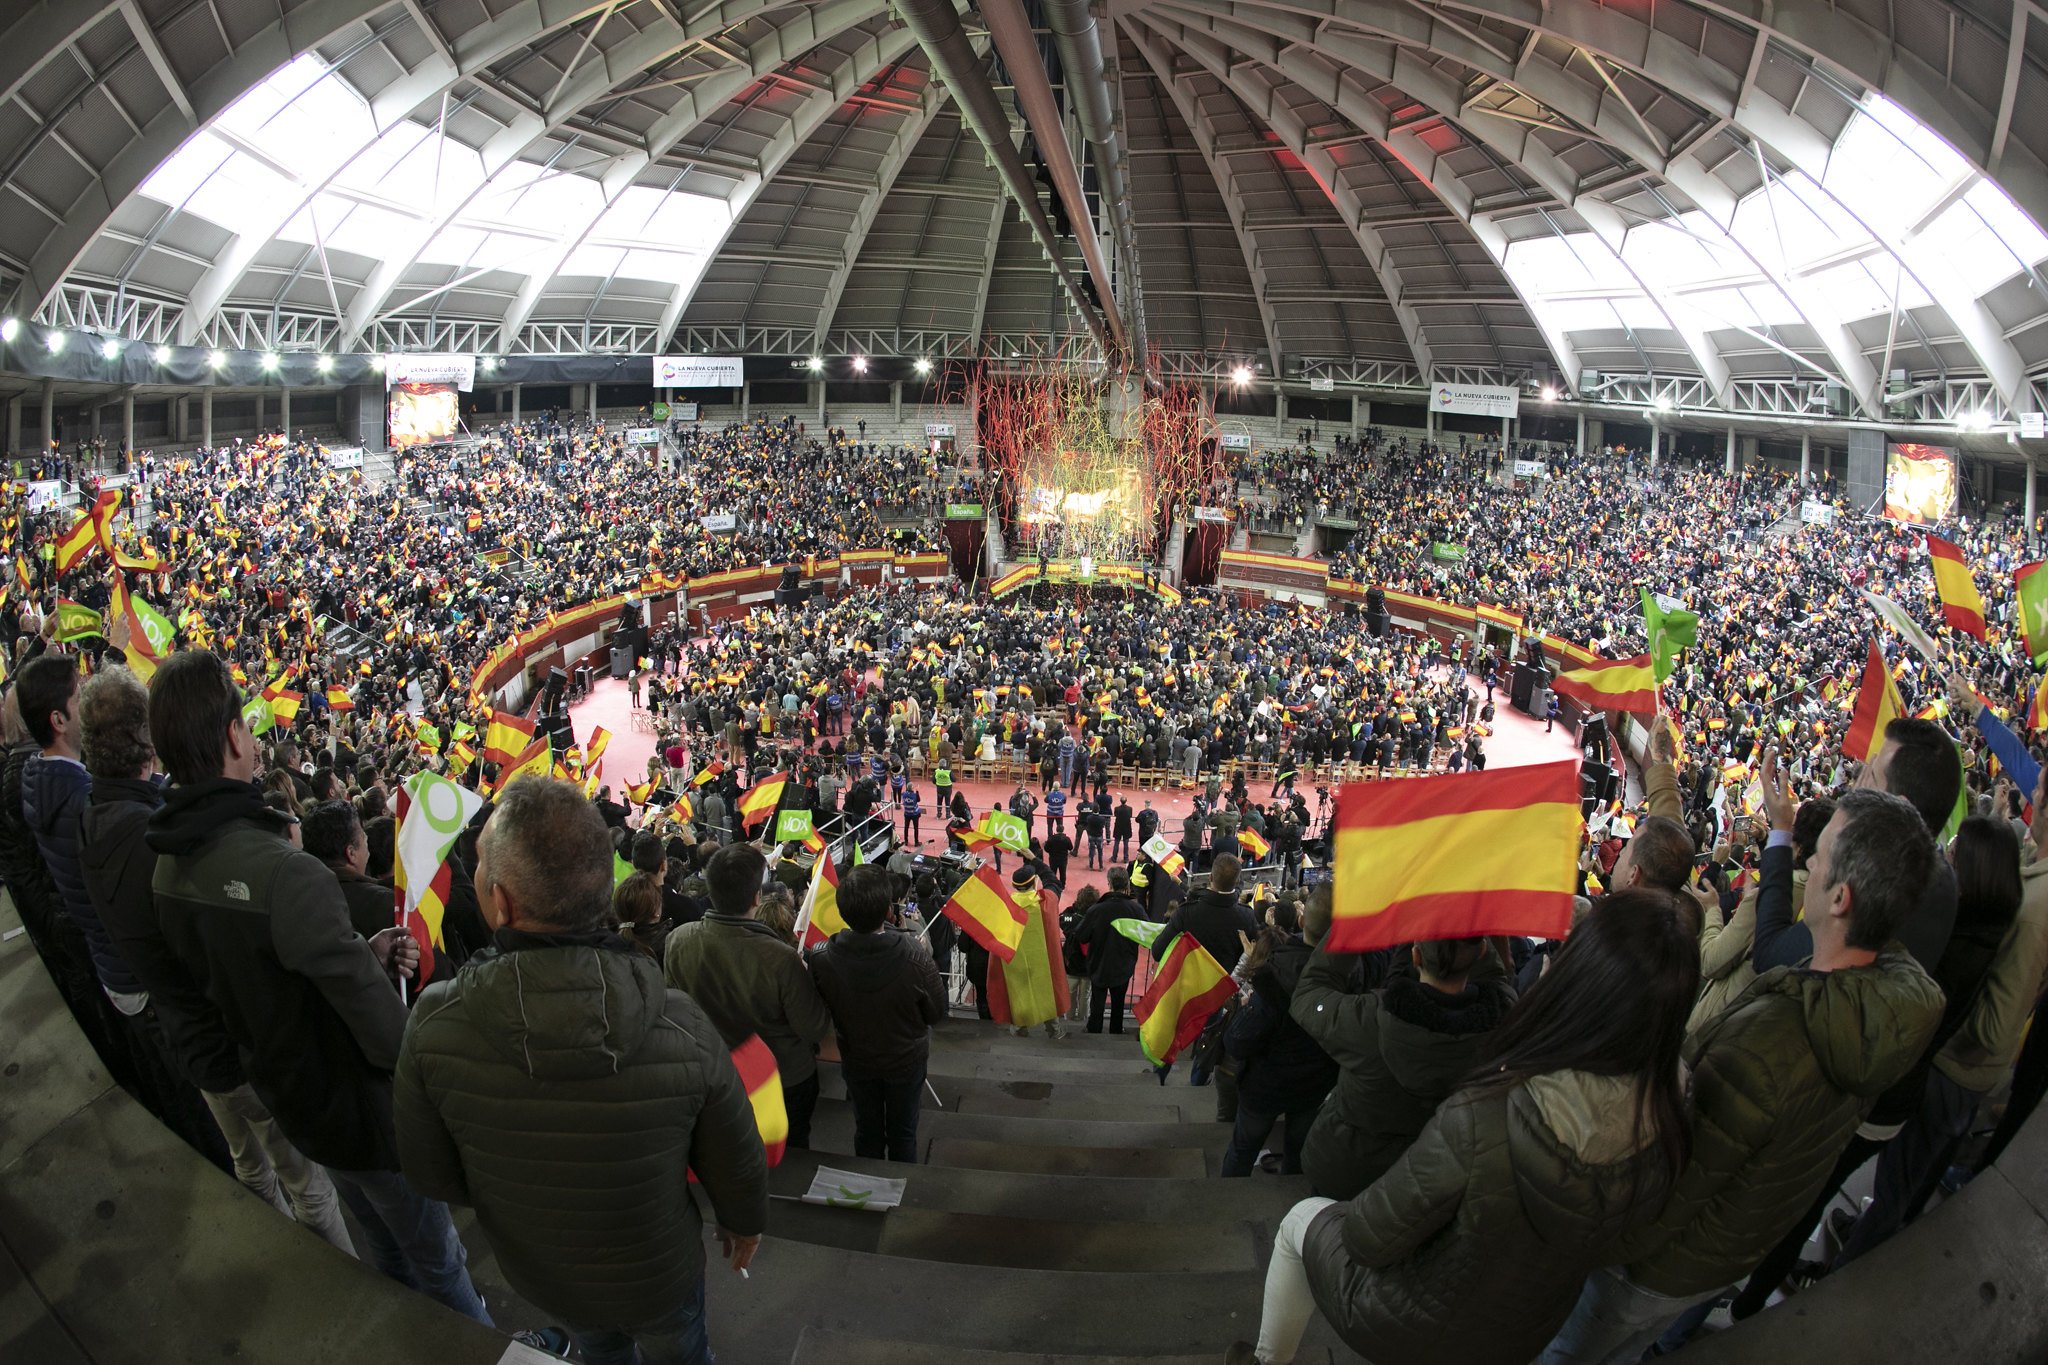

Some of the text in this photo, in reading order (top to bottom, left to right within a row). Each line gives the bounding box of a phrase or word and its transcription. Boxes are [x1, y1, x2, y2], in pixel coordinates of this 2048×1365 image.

[61, 614, 95, 631] VOX
[783, 816, 809, 832] VOX
[994, 821, 1023, 845] VOX
[1151, 840, 1166, 854] VO
